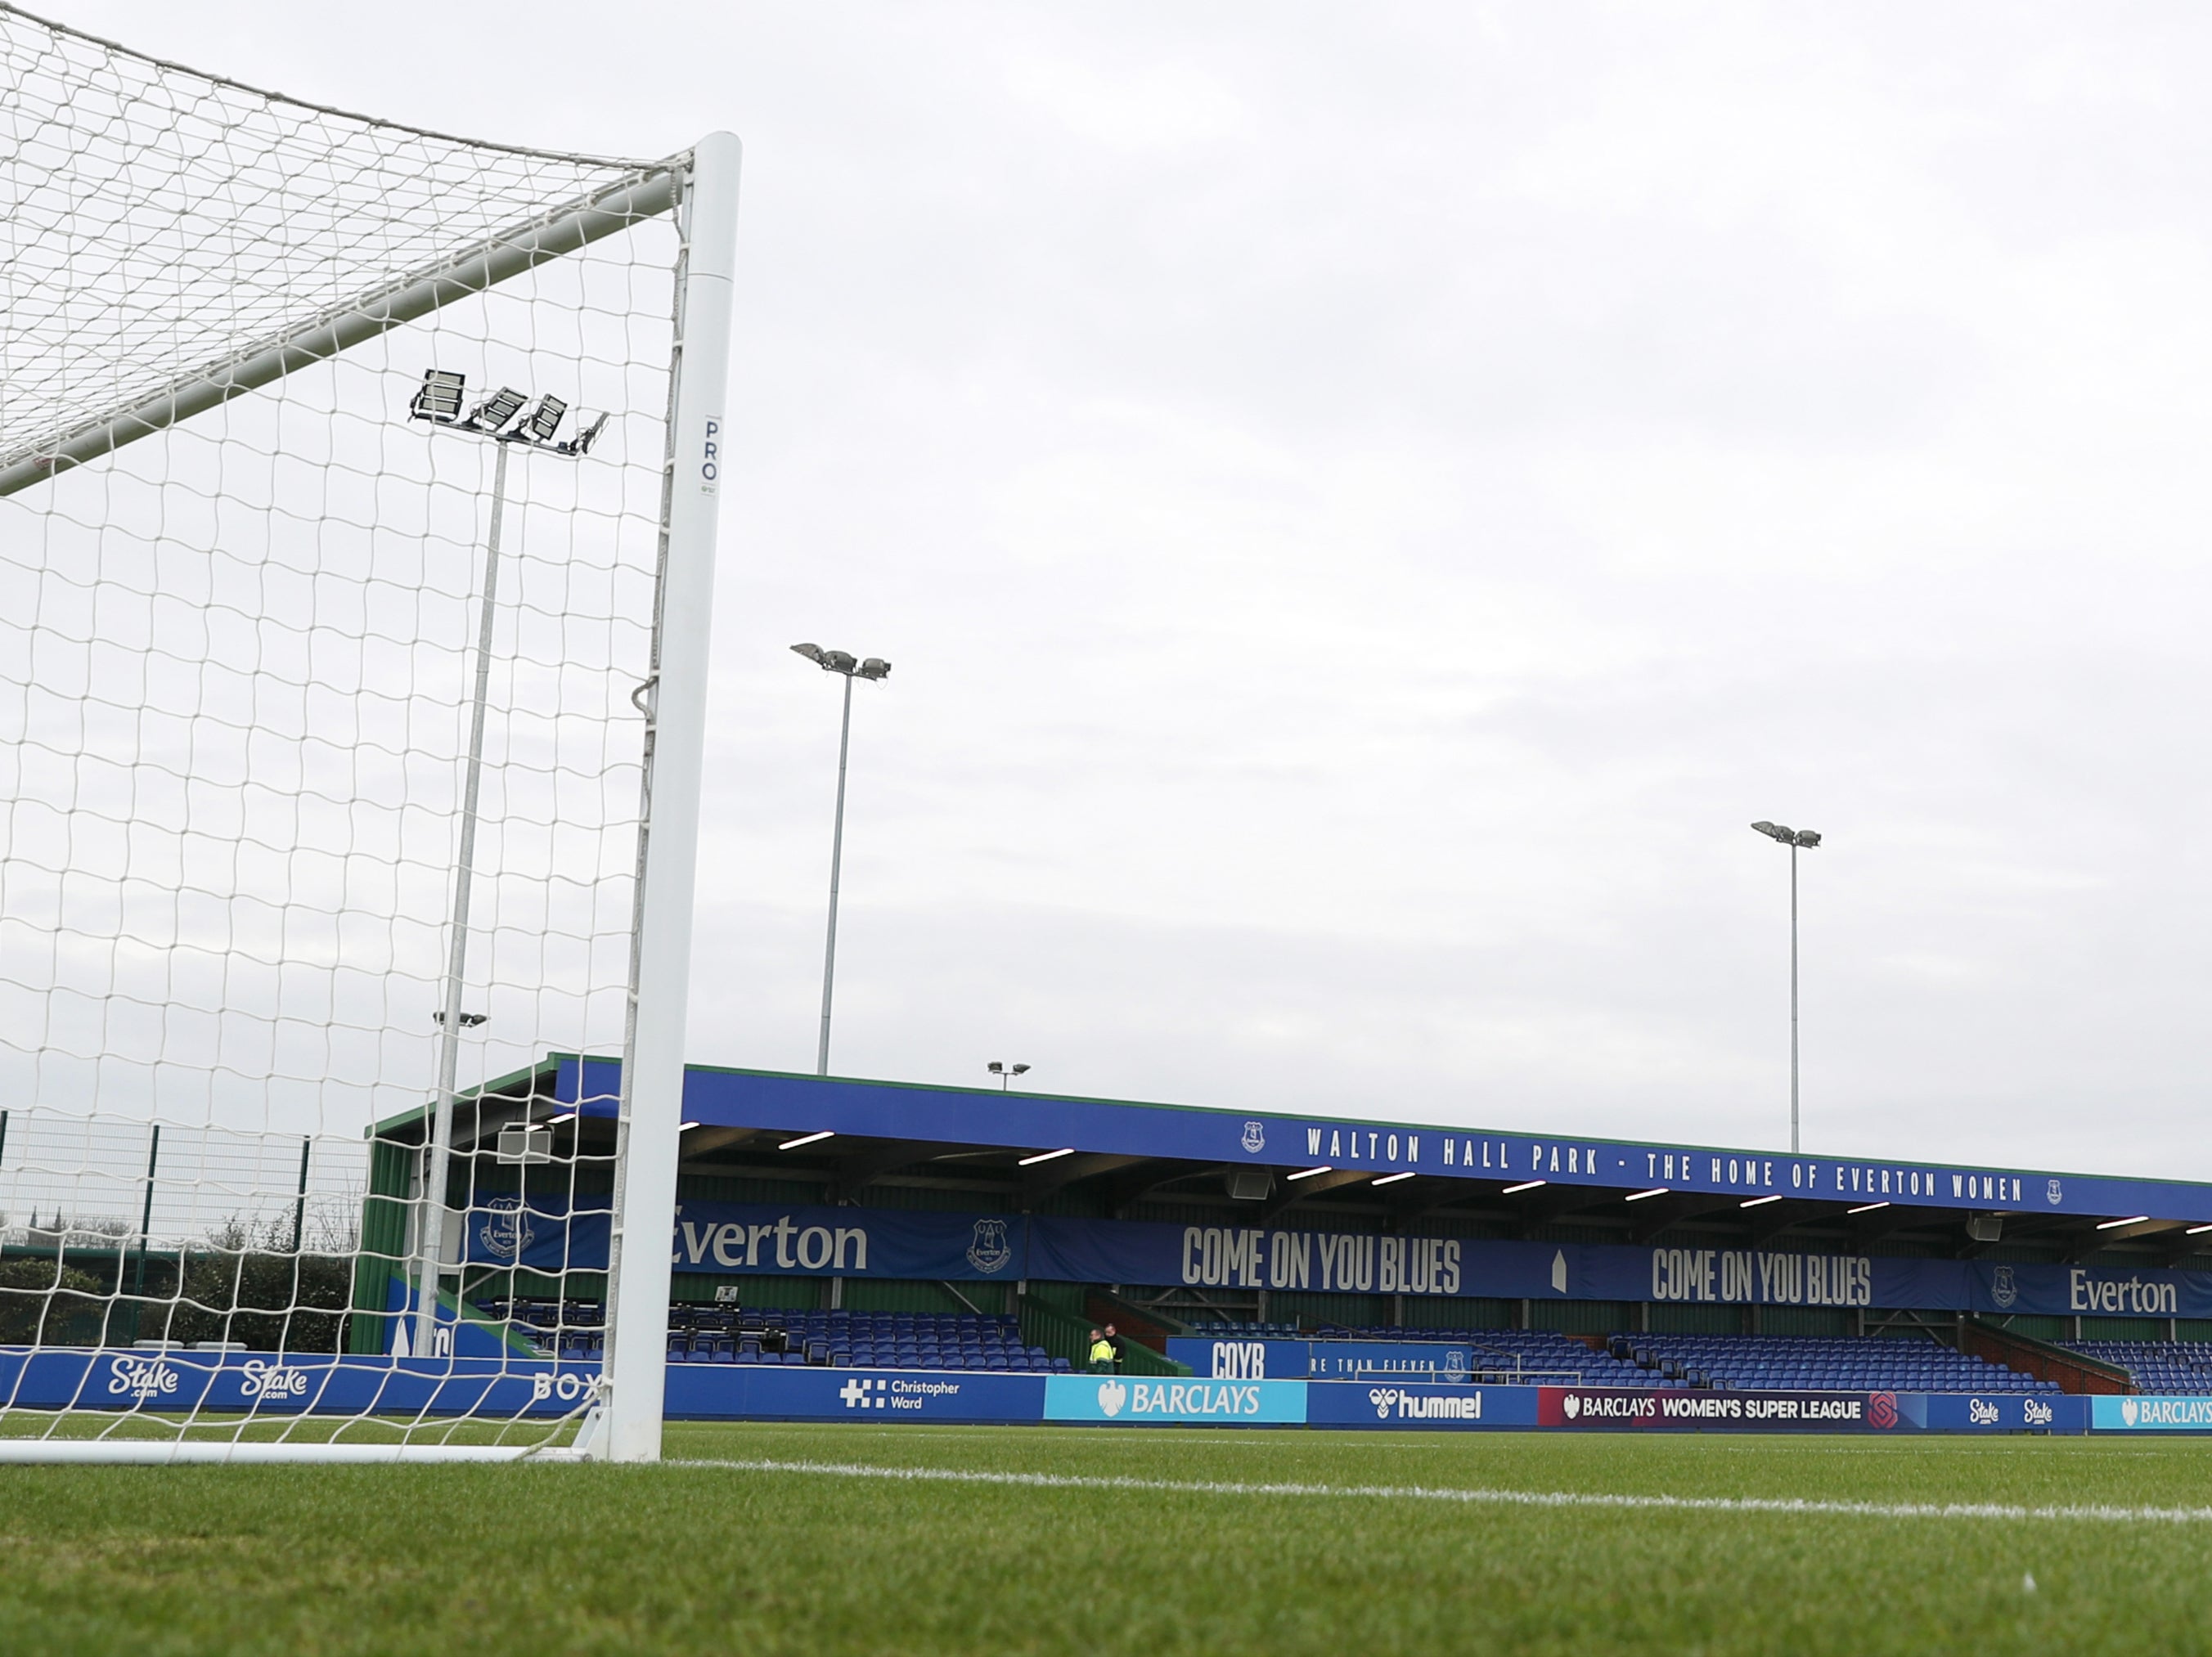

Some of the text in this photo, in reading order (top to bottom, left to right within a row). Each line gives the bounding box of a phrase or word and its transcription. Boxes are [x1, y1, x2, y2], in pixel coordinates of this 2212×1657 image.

[702, 420, 718, 480] PRO
[1307, 1128, 1419, 1163] WALTON
[1443, 1138, 1508, 1169] HALL
[1532, 1145, 1596, 1174] PARK
[1647, 1152, 1690, 1181] THE
[1711, 1158, 1773, 1186] HOME
[1792, 1163, 1817, 1189] OF
[1837, 1166, 1935, 1197] EVERTON
[1952, 1174, 2021, 1202] WOMEN
[672, 1205, 868, 1270] verton
[1182, 1227, 1461, 1294] COME ON YOU BLUES
[1652, 1248, 1871, 1306] COME ON YOU BLUES
[2070, 1269, 2178, 1313] Everton
[108, 1357, 178, 1394] Stake
[241, 1359, 308, 1395] Stake
[1212, 1341, 1266, 1380] COYB
[1337, 1358, 1373, 1372] THAN
[891, 1380, 960, 1397] Christopher
[891, 1396, 923, 1409] Ward
[1131, 1384, 1261, 1415] BARCLAYS
[1398, 1389, 1481, 1419] hummel
[1583, 1397, 1862, 1420] BARCLAYS WOMEN'S SUPER LEAGUE
[1970, 1398, 1999, 1423] Stake
[2024, 1399, 2052, 1423] Stake
[2141, 1401, 2212, 1424] BARCLAYS
